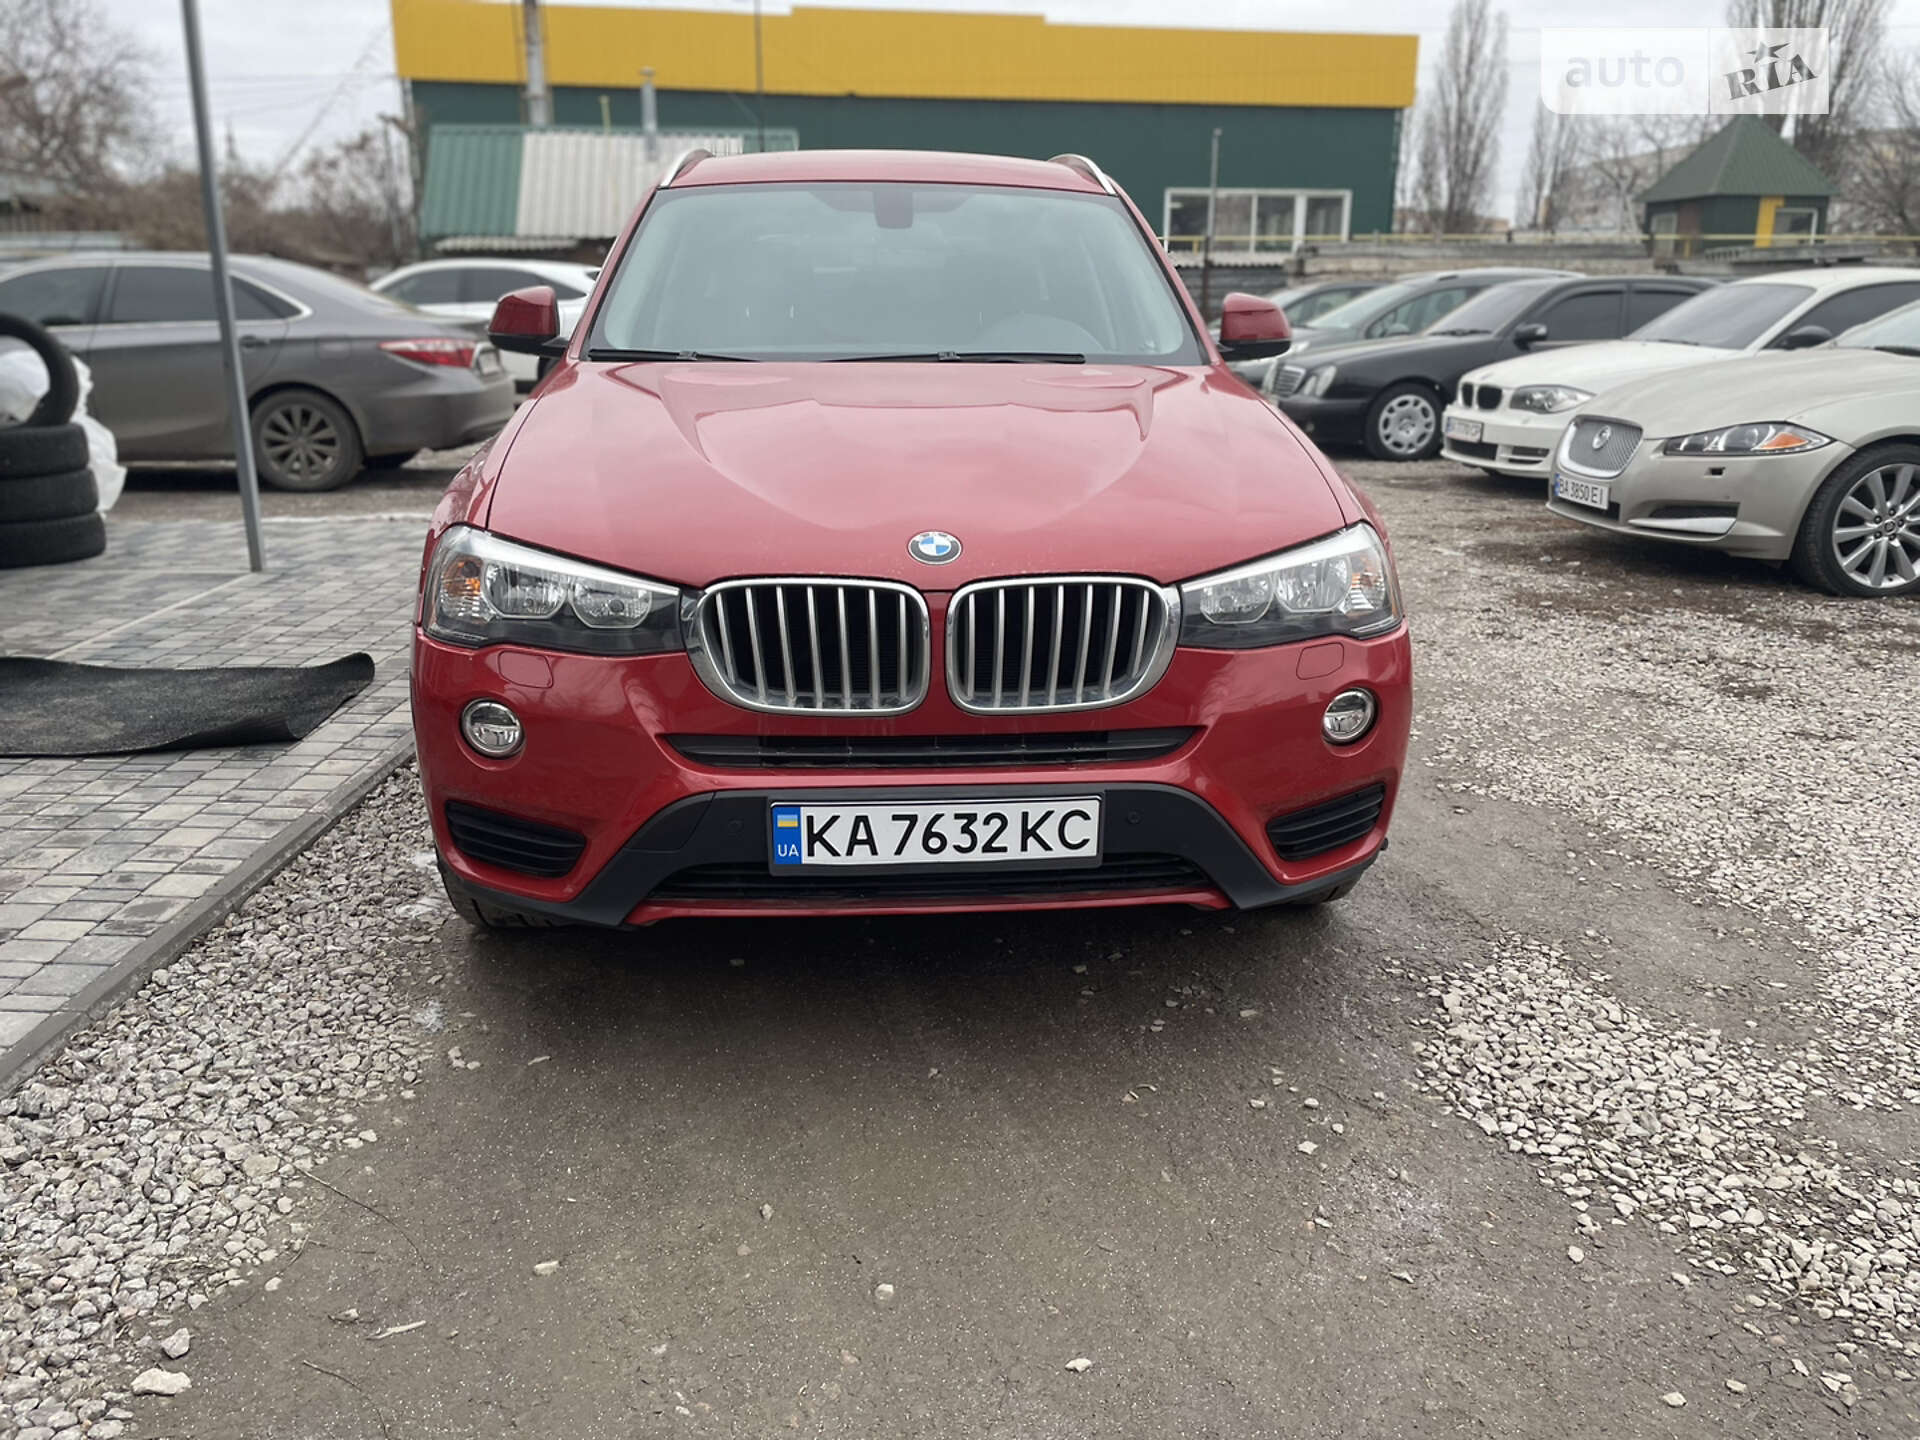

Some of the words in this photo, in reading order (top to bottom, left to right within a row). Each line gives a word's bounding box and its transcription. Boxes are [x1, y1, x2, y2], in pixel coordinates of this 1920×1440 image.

[806, 814, 878, 857] KA
[891, 812, 1008, 855] 7632
[1020, 809, 1091, 852] KC
[777, 844, 799, 857] UA
